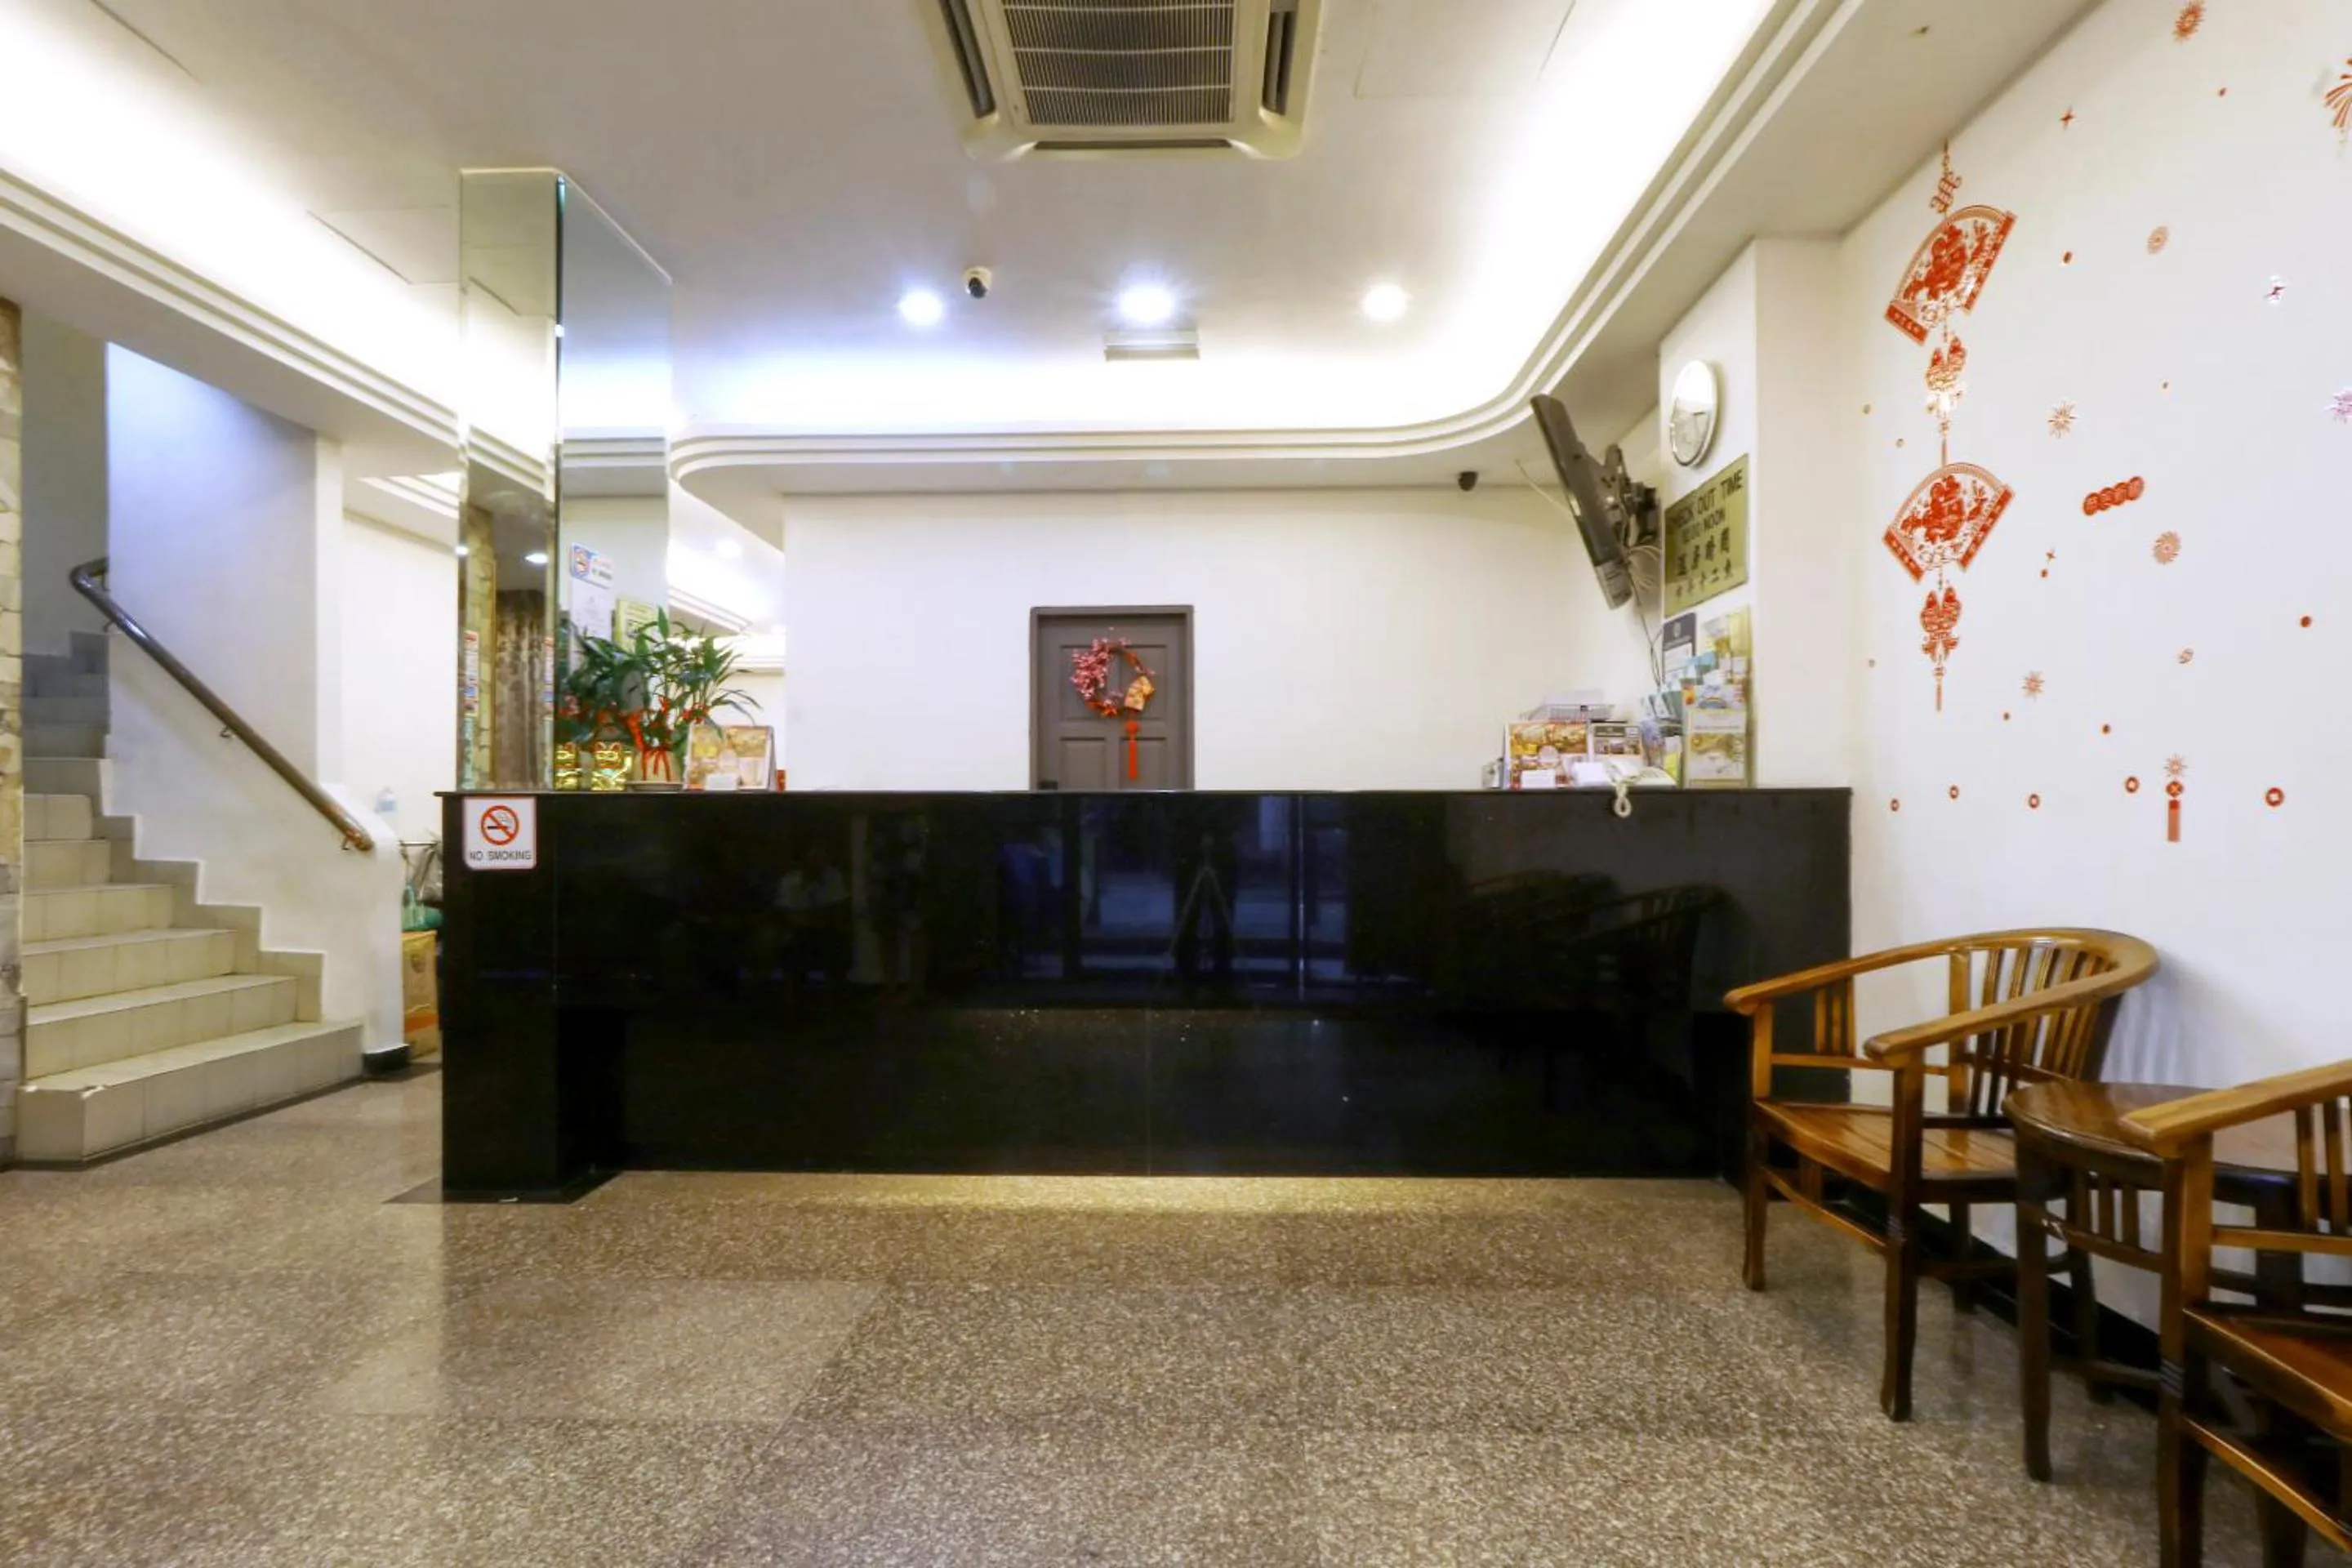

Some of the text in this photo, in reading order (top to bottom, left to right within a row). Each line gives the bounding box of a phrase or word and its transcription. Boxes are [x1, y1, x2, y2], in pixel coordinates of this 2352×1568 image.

[1698, 488, 1716, 514] OUT
[1720, 469, 1743, 500] TIME
[1704, 508, 1726, 532] NOON
[470, 850, 532, 861] NO SMOKING
